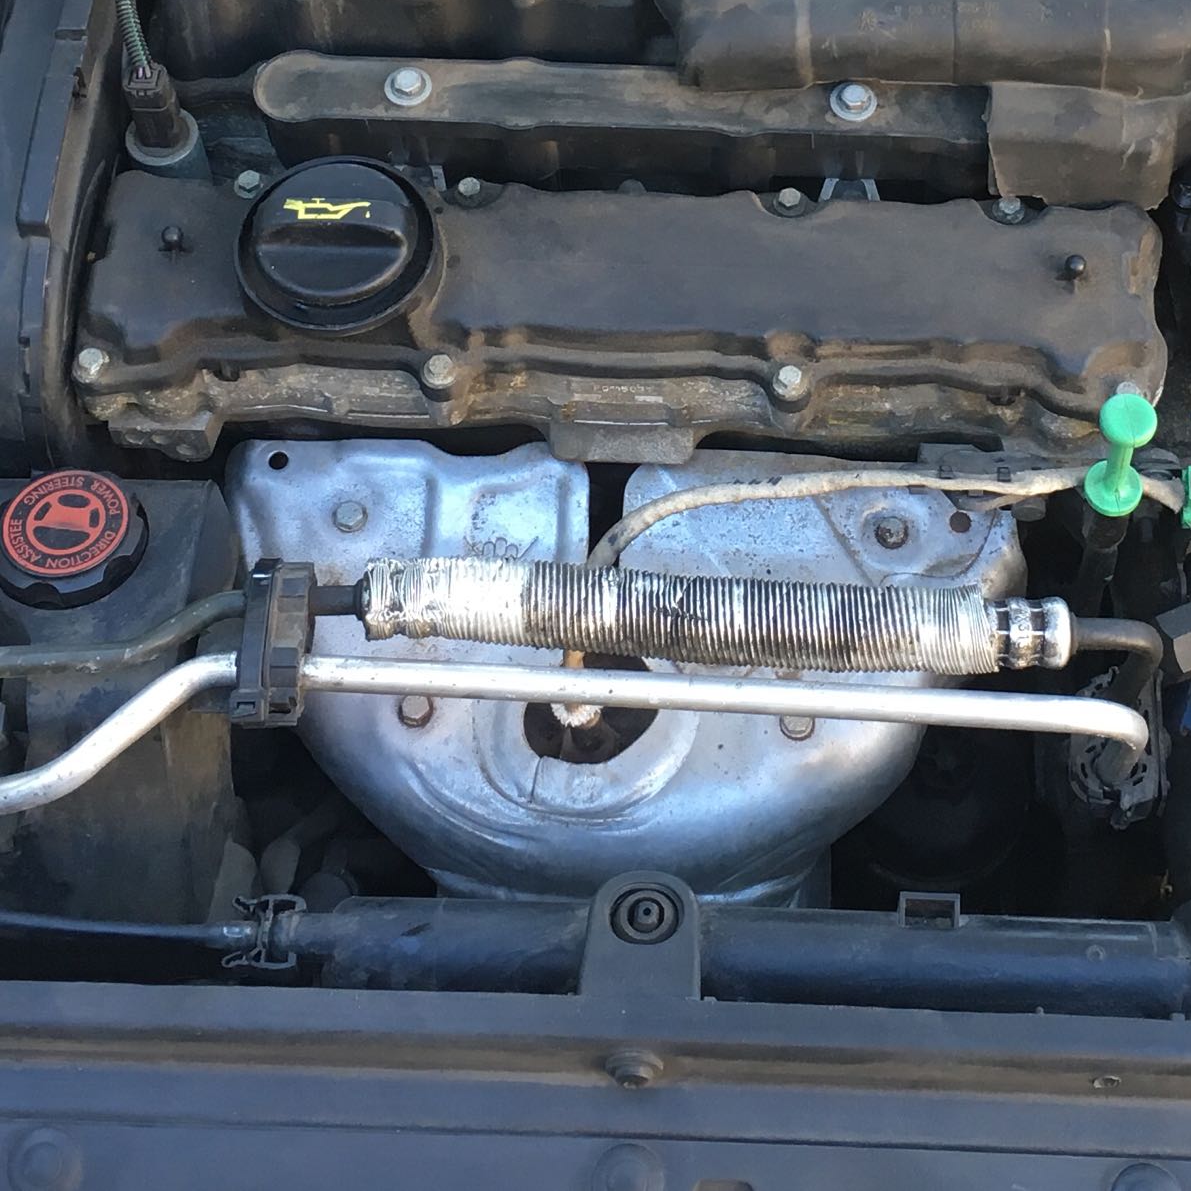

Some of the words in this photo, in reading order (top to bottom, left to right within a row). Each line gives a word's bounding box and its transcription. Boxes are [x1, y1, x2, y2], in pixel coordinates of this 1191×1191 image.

[23, 475, 86, 507] STEERING
[90, 479, 121, 517] POWER
[44, 530, 117, 569] DIRECTION
